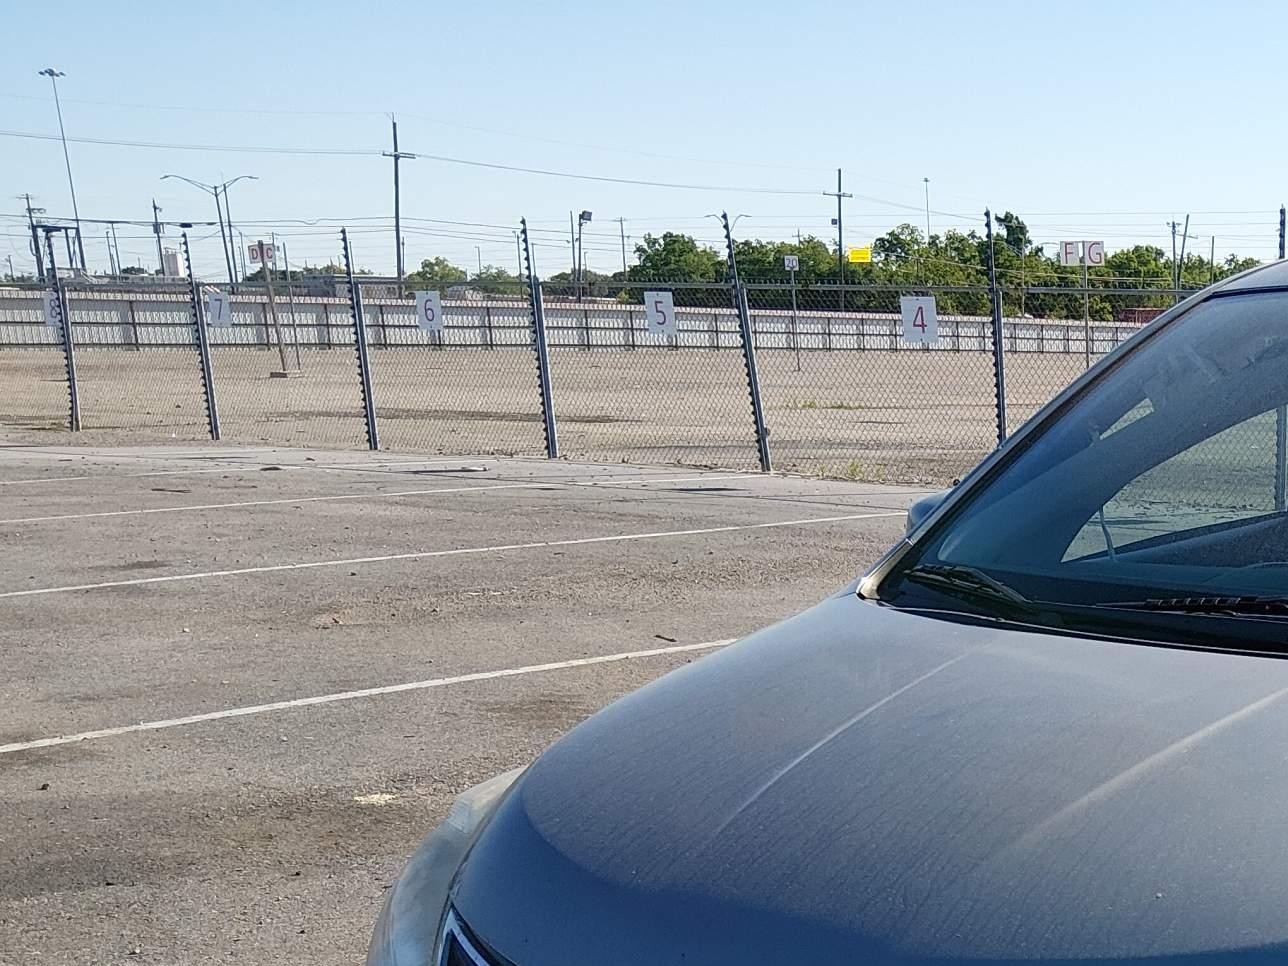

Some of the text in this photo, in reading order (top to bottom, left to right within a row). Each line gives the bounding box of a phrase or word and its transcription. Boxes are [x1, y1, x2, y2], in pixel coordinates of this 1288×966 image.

[251, 246, 274, 260] D C
[785, 257, 798, 268] 20
[1064, 242, 1103, 265] F G
[49, 299, 61, 319] 8
[214, 298, 223, 320] 7
[424, 298, 436, 322] 6
[655, 300, 668, 325] 5
[912, 305, 928, 333] 4
